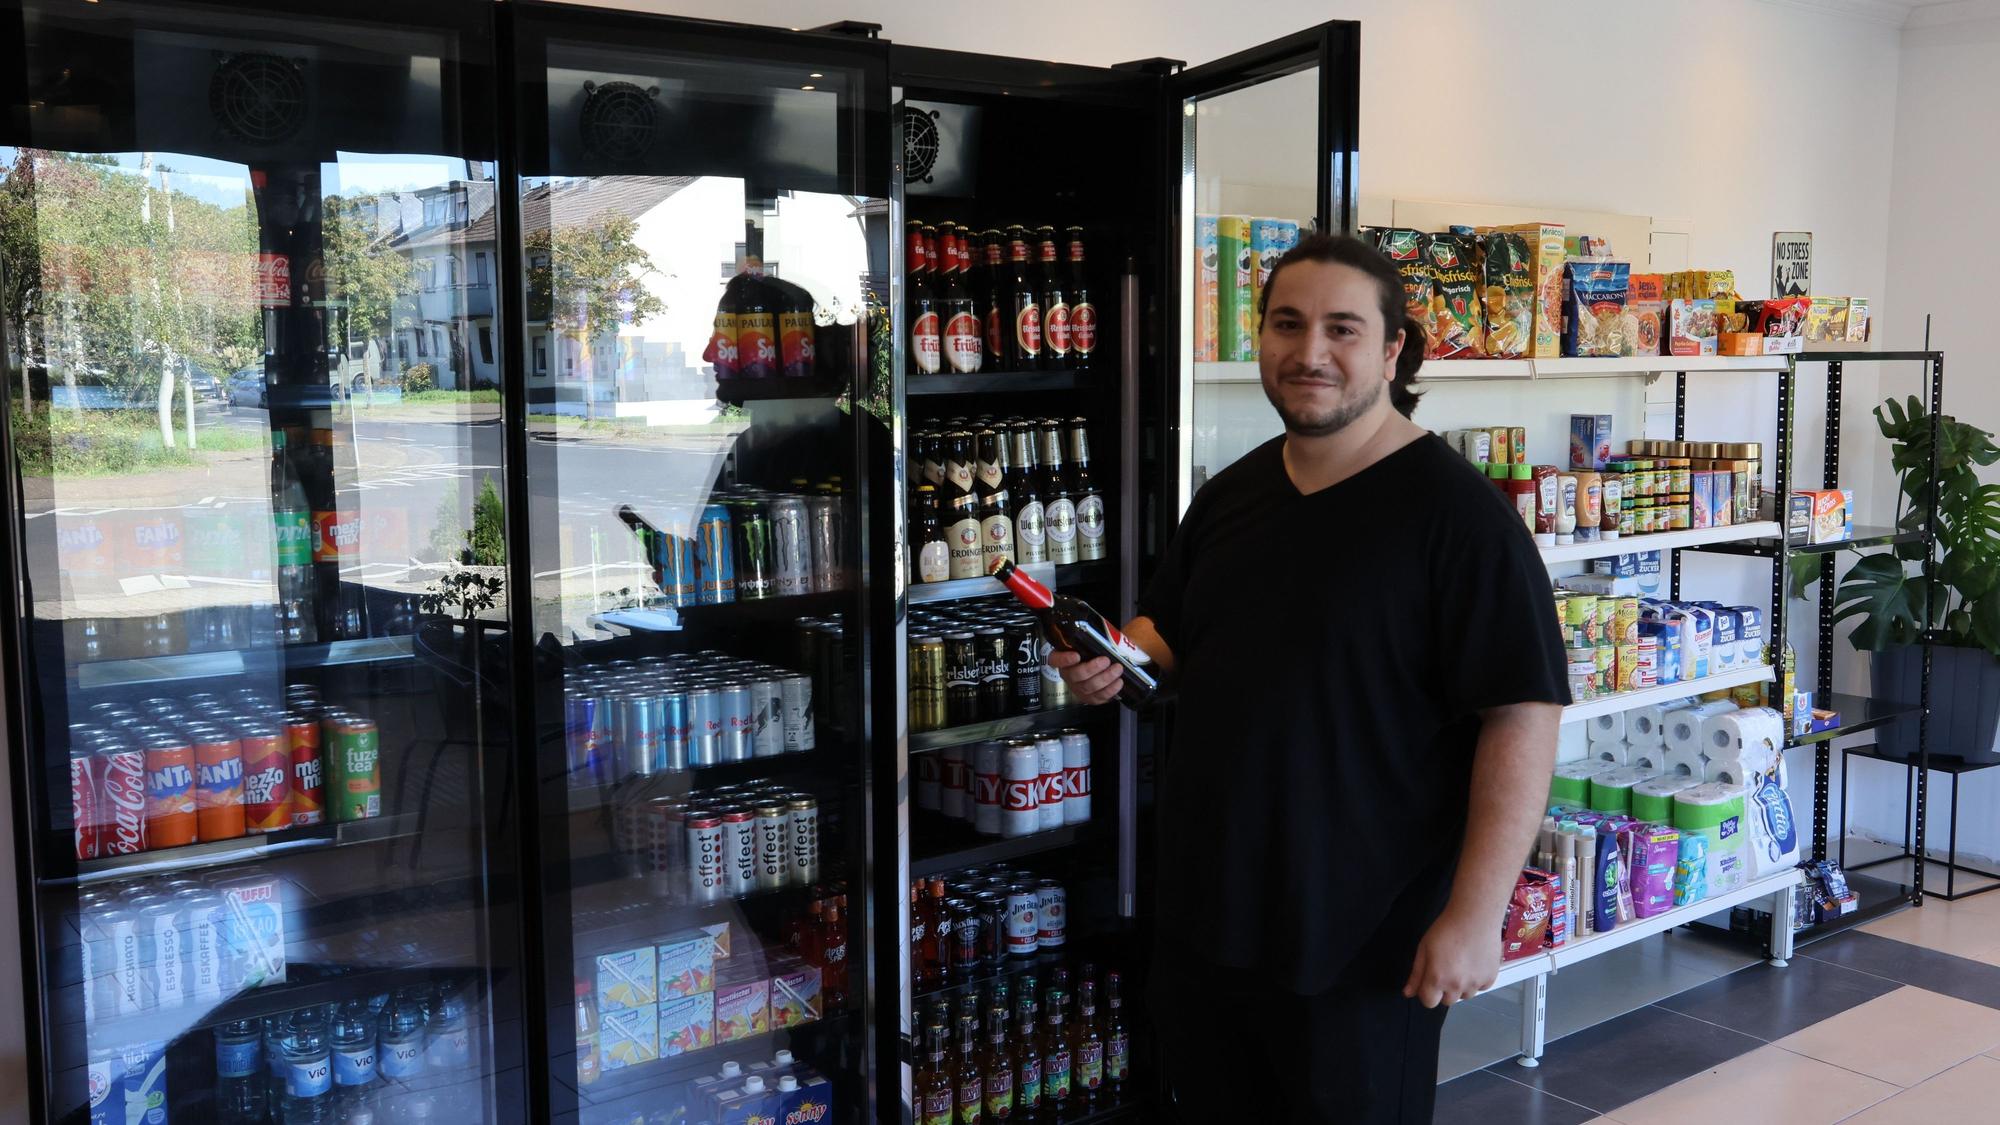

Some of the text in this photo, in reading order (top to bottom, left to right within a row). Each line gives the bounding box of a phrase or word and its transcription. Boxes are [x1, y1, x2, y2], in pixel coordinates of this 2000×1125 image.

[1776, 242, 1809, 260] NO STRESS
[1791, 262, 1809, 280] ZONE
[920, 337, 941, 353] frü
[347, 748, 378, 761] fuze
[149, 764, 193, 790] ANTA
[347, 760, 373, 773] tea
[763, 823, 778, 876] effect
[795, 816, 809, 868] effect
[699, 834, 714, 888] effect
[738, 826, 752, 881] effect
[1012, 903, 1027, 916] JIM
[163, 930, 176, 992] ESPRESSO
[199, 922, 211, 985] EISKAFFEE
[308, 1066, 328, 1080] ViO
